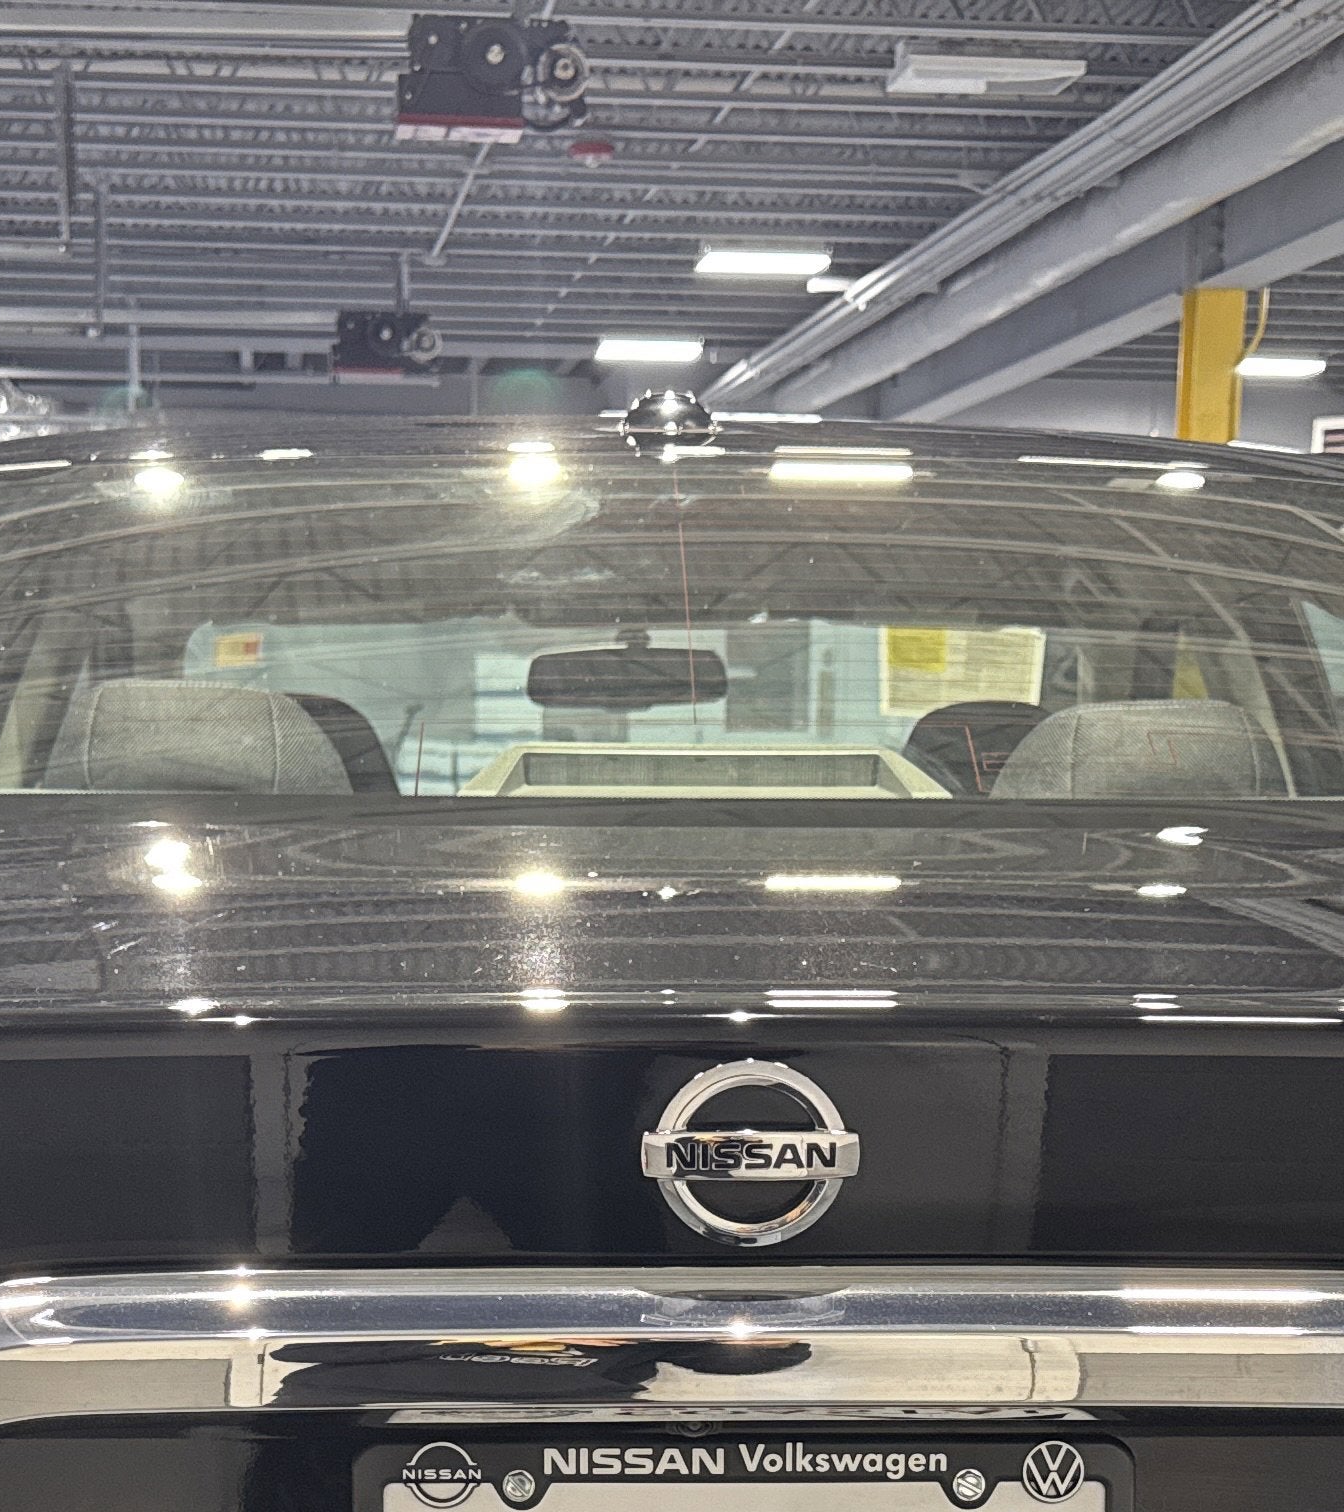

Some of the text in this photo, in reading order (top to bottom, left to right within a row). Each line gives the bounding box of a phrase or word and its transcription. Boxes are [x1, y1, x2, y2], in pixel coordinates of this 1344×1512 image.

[665, 1142, 837, 1170] NISSAN
[402, 1468, 482, 1480] NISSAN
[543, 1442, 947, 1480] NISSAN Volkswagen
